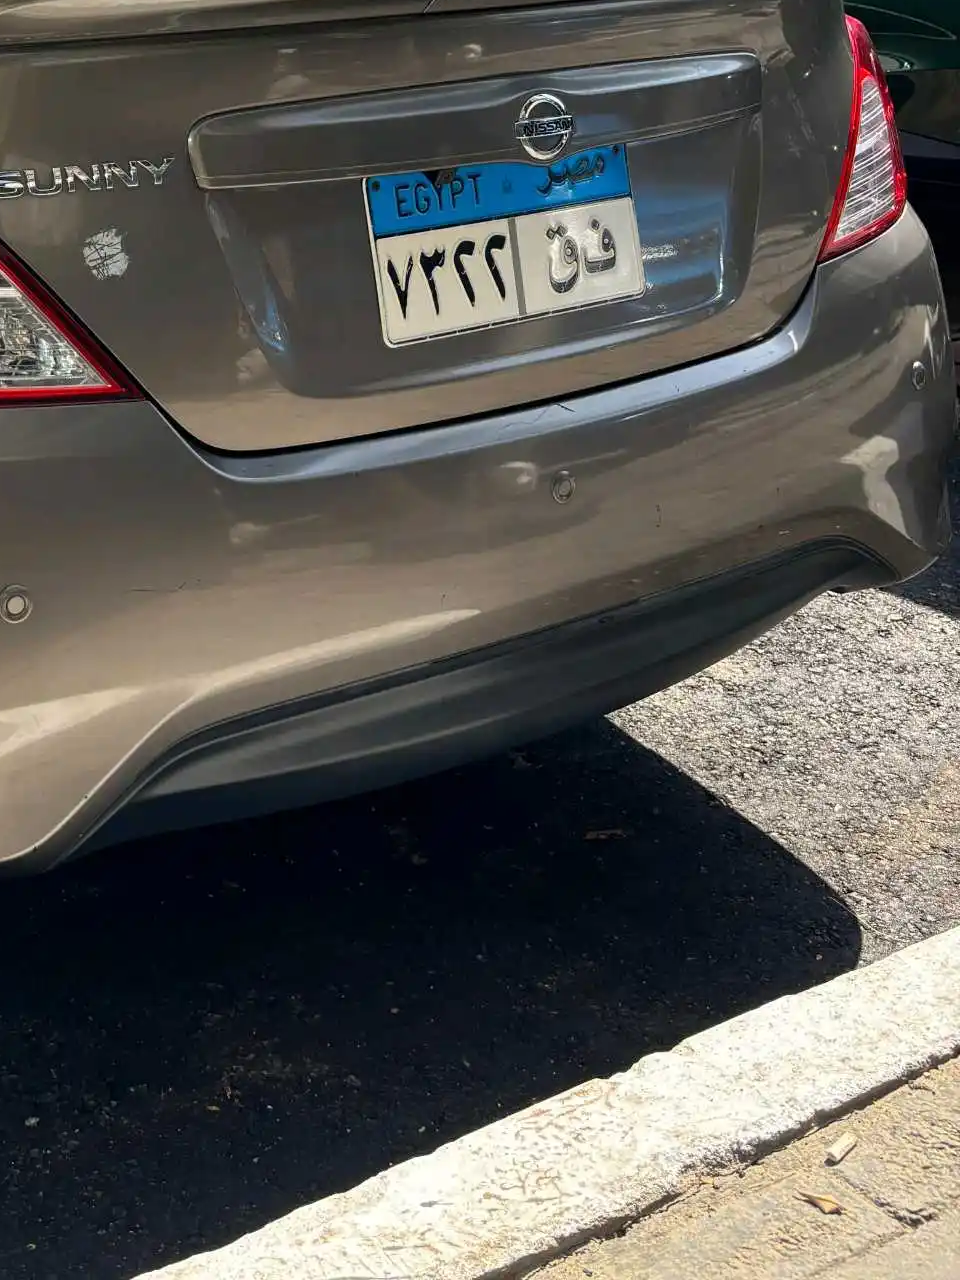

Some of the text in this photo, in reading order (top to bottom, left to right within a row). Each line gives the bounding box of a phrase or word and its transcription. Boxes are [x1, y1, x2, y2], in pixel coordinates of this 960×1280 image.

[523, 119, 572, 136] NISSAN
[537, 154, 606, 195] مصر
[394, 174, 481, 218] EGYPT
[386, 234, 507, 320] ٧٣٢٢
